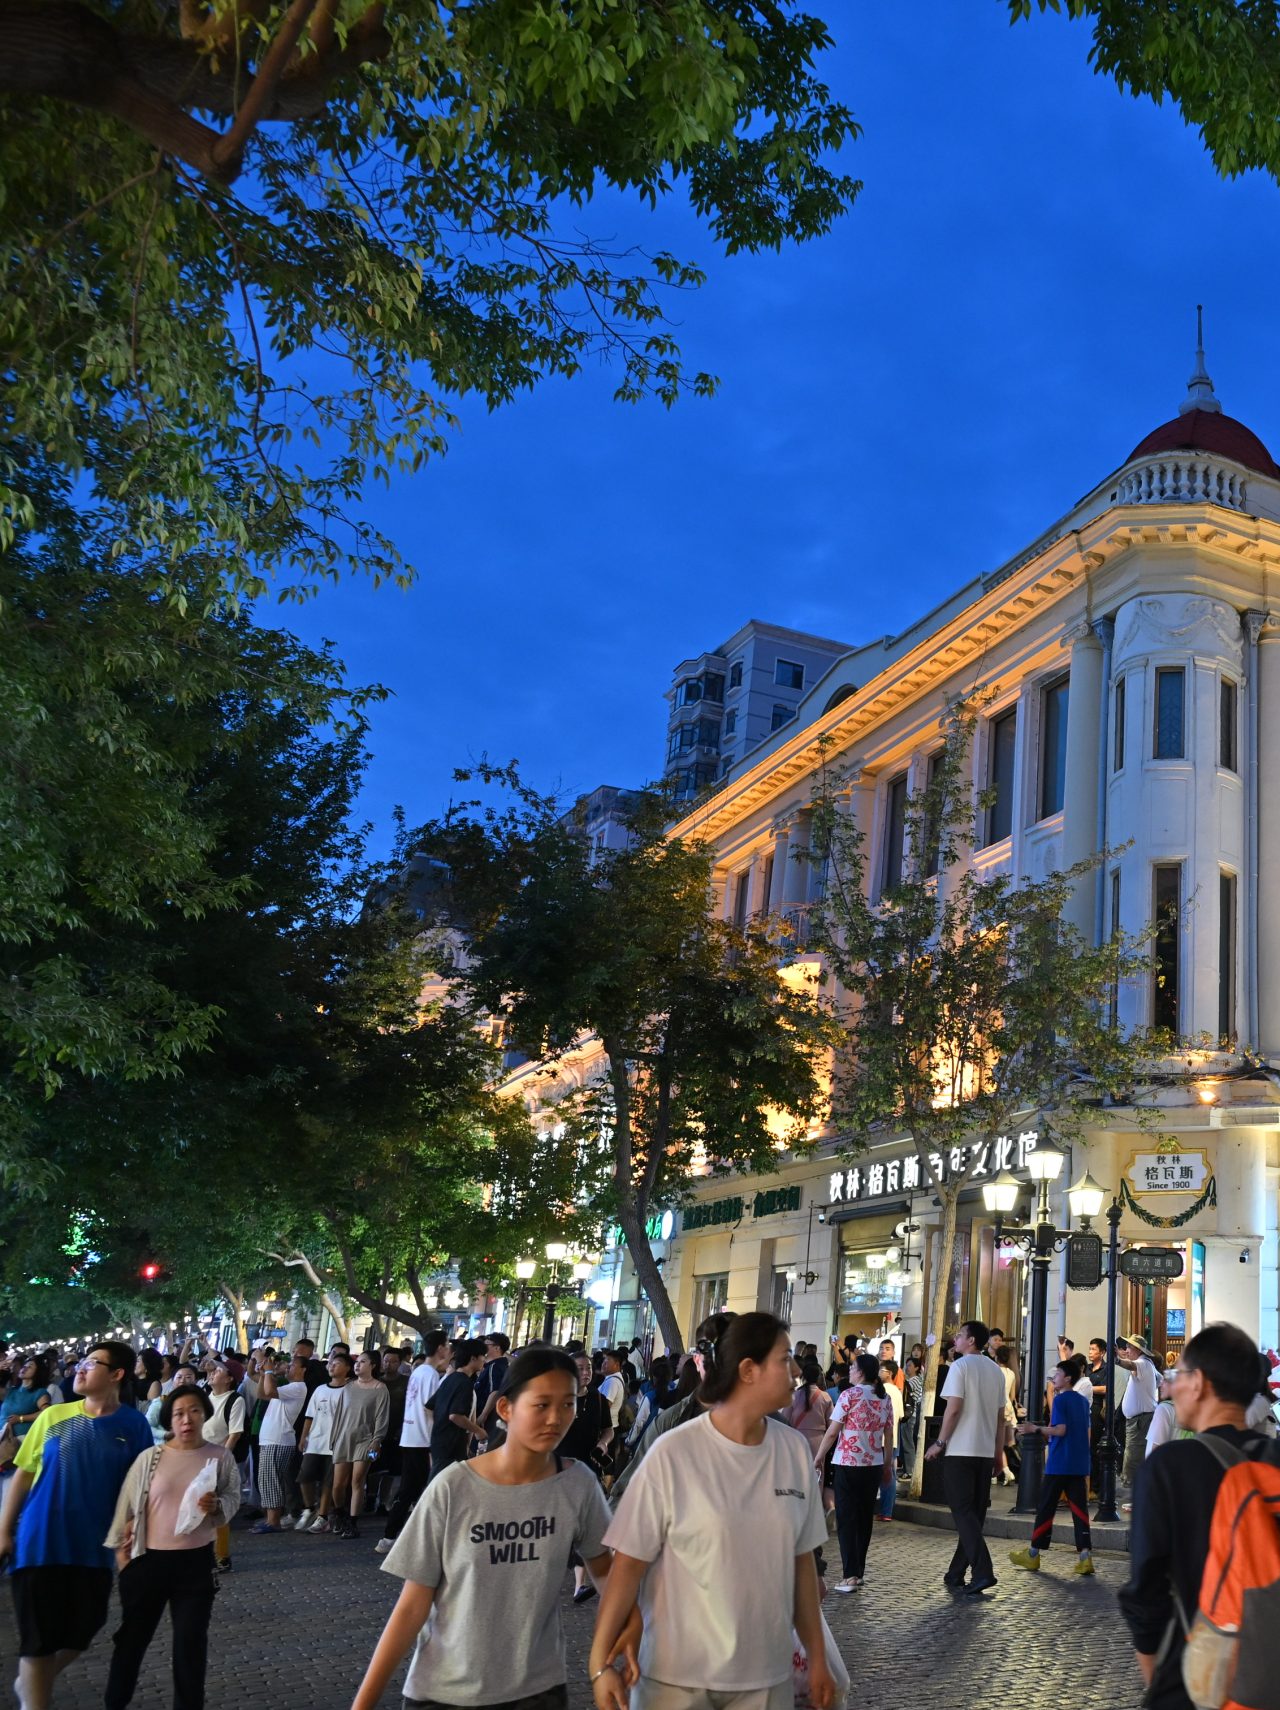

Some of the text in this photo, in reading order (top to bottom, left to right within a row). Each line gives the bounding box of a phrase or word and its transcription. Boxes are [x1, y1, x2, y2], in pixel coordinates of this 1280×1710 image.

[1157, 1155, 1181, 1165] 秋林
[1145, 1166, 1194, 1180] 格瓦斯
[1172, 1181, 1190, 1189] 1900
[471, 1516, 555, 1543] SMOOTH
[489, 1542, 539, 1564] WILL
